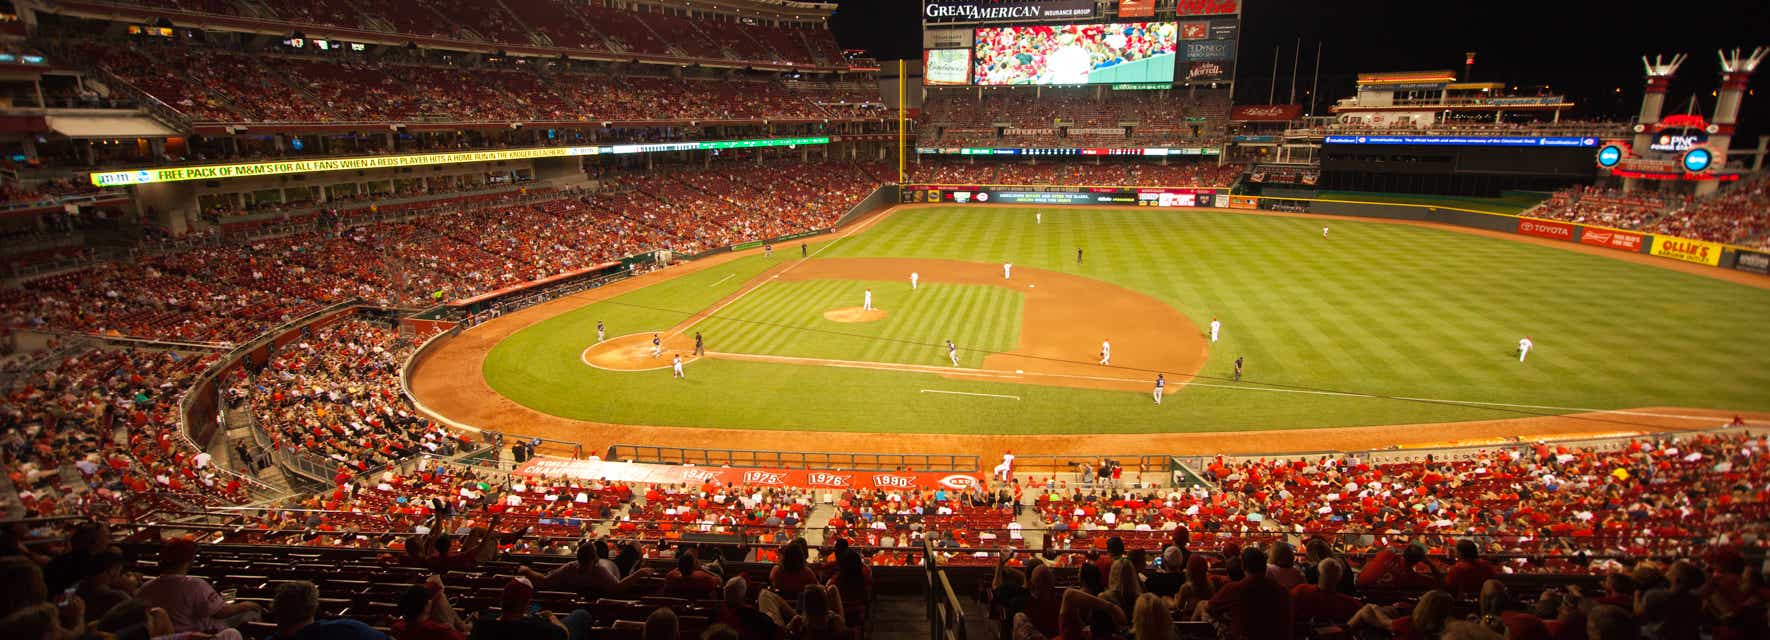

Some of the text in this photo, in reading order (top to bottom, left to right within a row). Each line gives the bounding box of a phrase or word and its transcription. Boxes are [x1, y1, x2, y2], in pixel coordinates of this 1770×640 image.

[1671, 136, 1697, 148] PNC
[159, 168, 185, 180] FREE
[187, 167, 217, 178] PACK
[219, 166, 233, 176] OF
[235, 164, 274, 175] M&M'S
[275, 164, 293, 173] FOR
[295, 162, 312, 172] ALL
[314, 160, 339, 171] FANS
[340, 159, 368, 170] WHEN
[370, 159, 376, 167] A
[377, 157, 399, 167] REDS
[400, 156, 429, 165] PLAYER
[1535, 225, 1568, 236] TOYOTA
[747, 472, 777, 483] 1975
[811, 474, 842, 486] 1976
[876, 475, 907, 487] 1990
